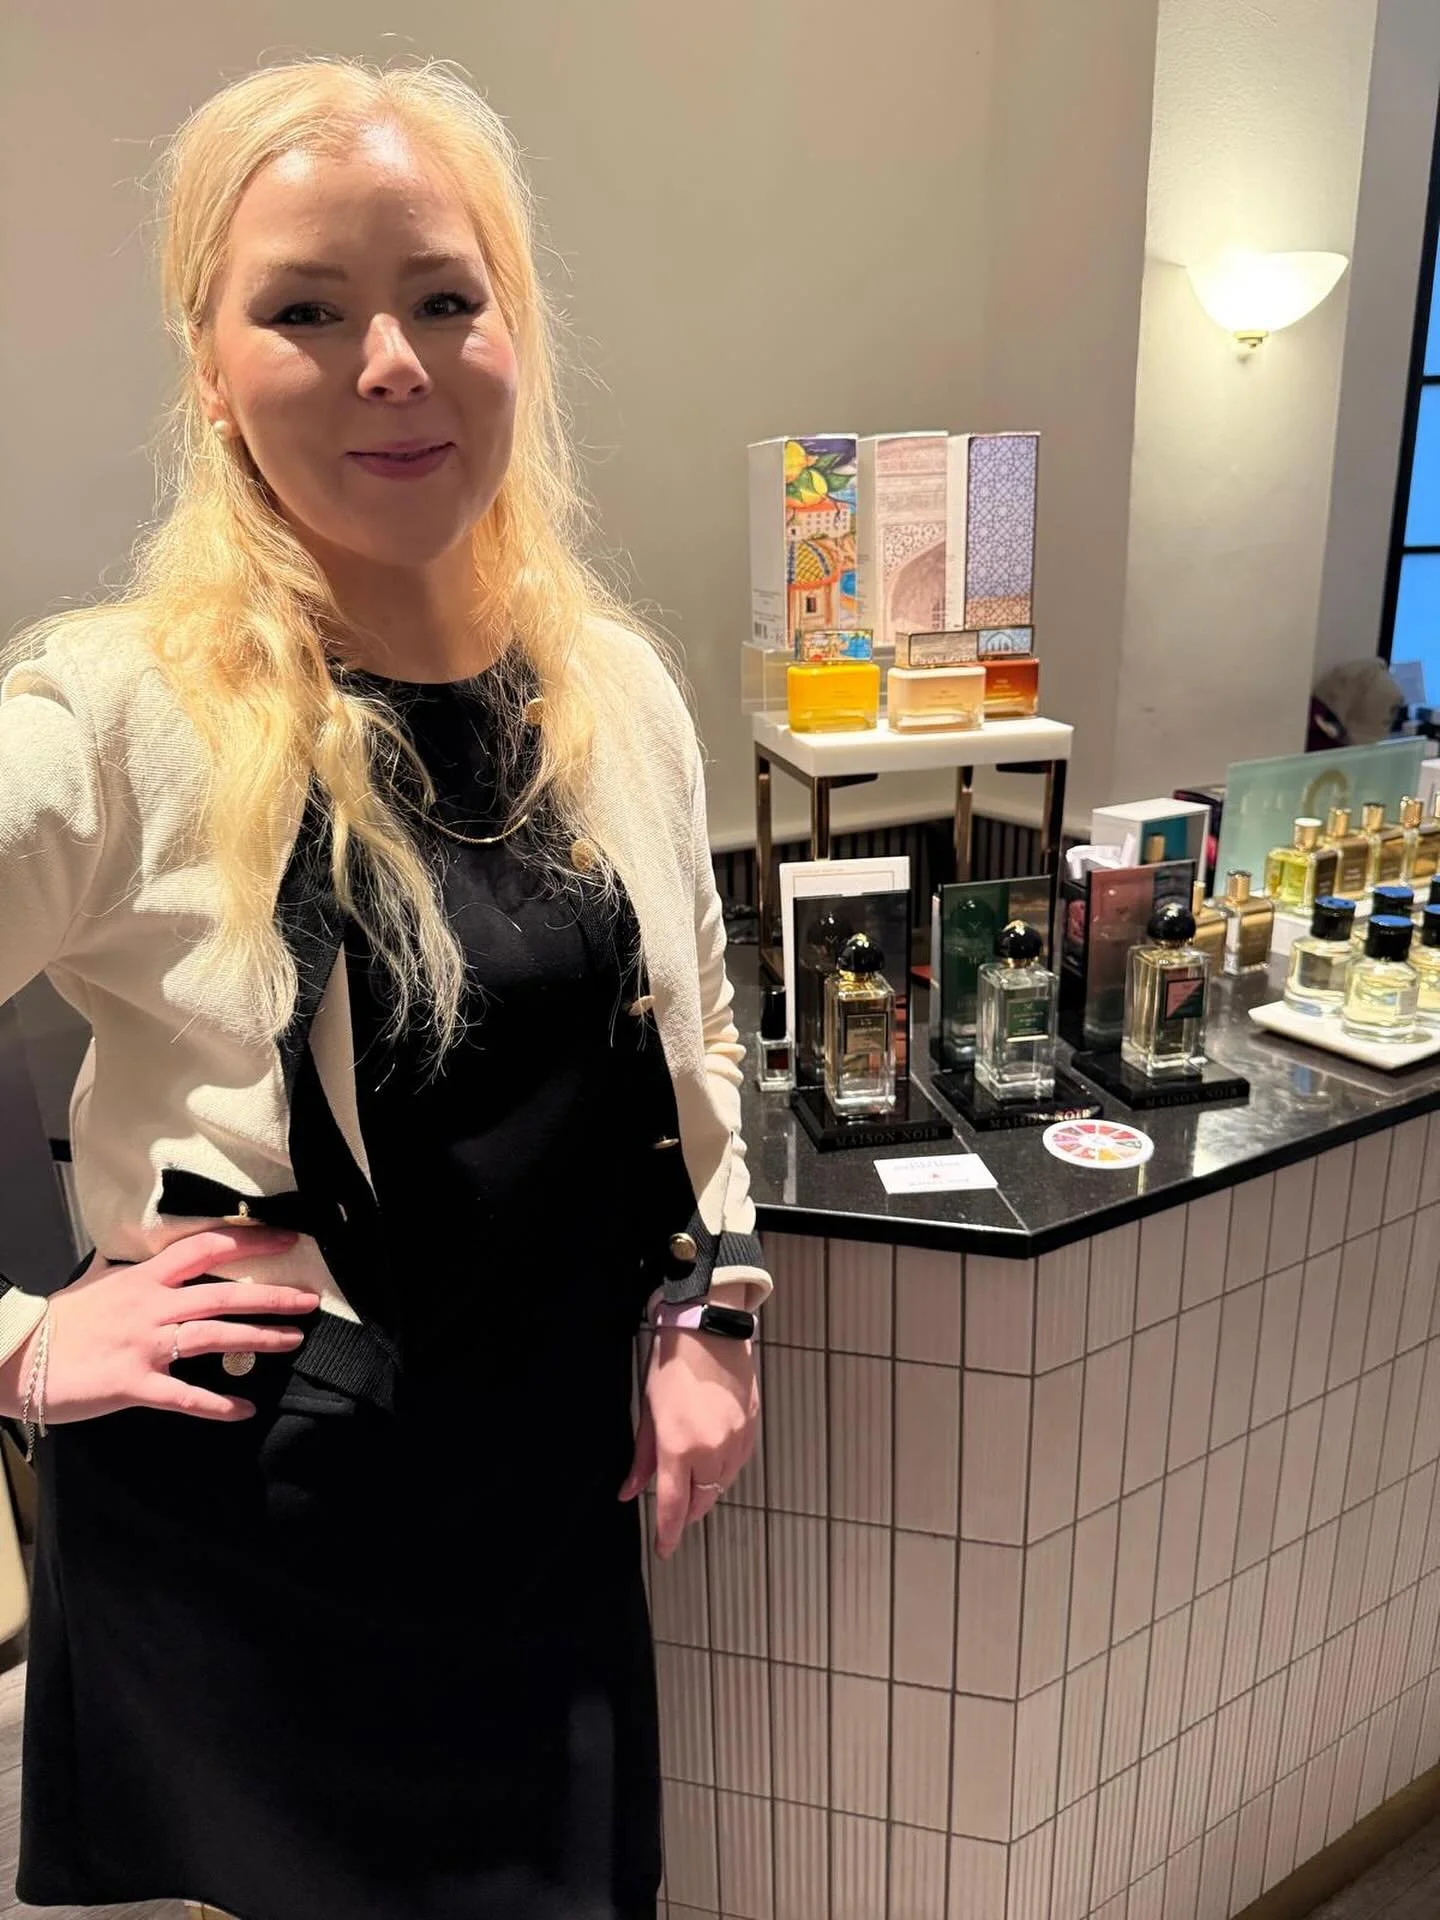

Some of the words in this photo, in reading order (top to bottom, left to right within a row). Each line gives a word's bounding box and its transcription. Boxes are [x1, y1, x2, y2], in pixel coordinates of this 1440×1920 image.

[1145, 1092, 1200, 1107] MAISON
[1205, 1086, 1238, 1100] NOIR
[989, 1112, 1047, 1129] MAISON
[1054, 1107, 1091, 1121] NOIR
[835, 1130, 896, 1148] MAISON
[902, 1127, 940, 1142] NOIR
